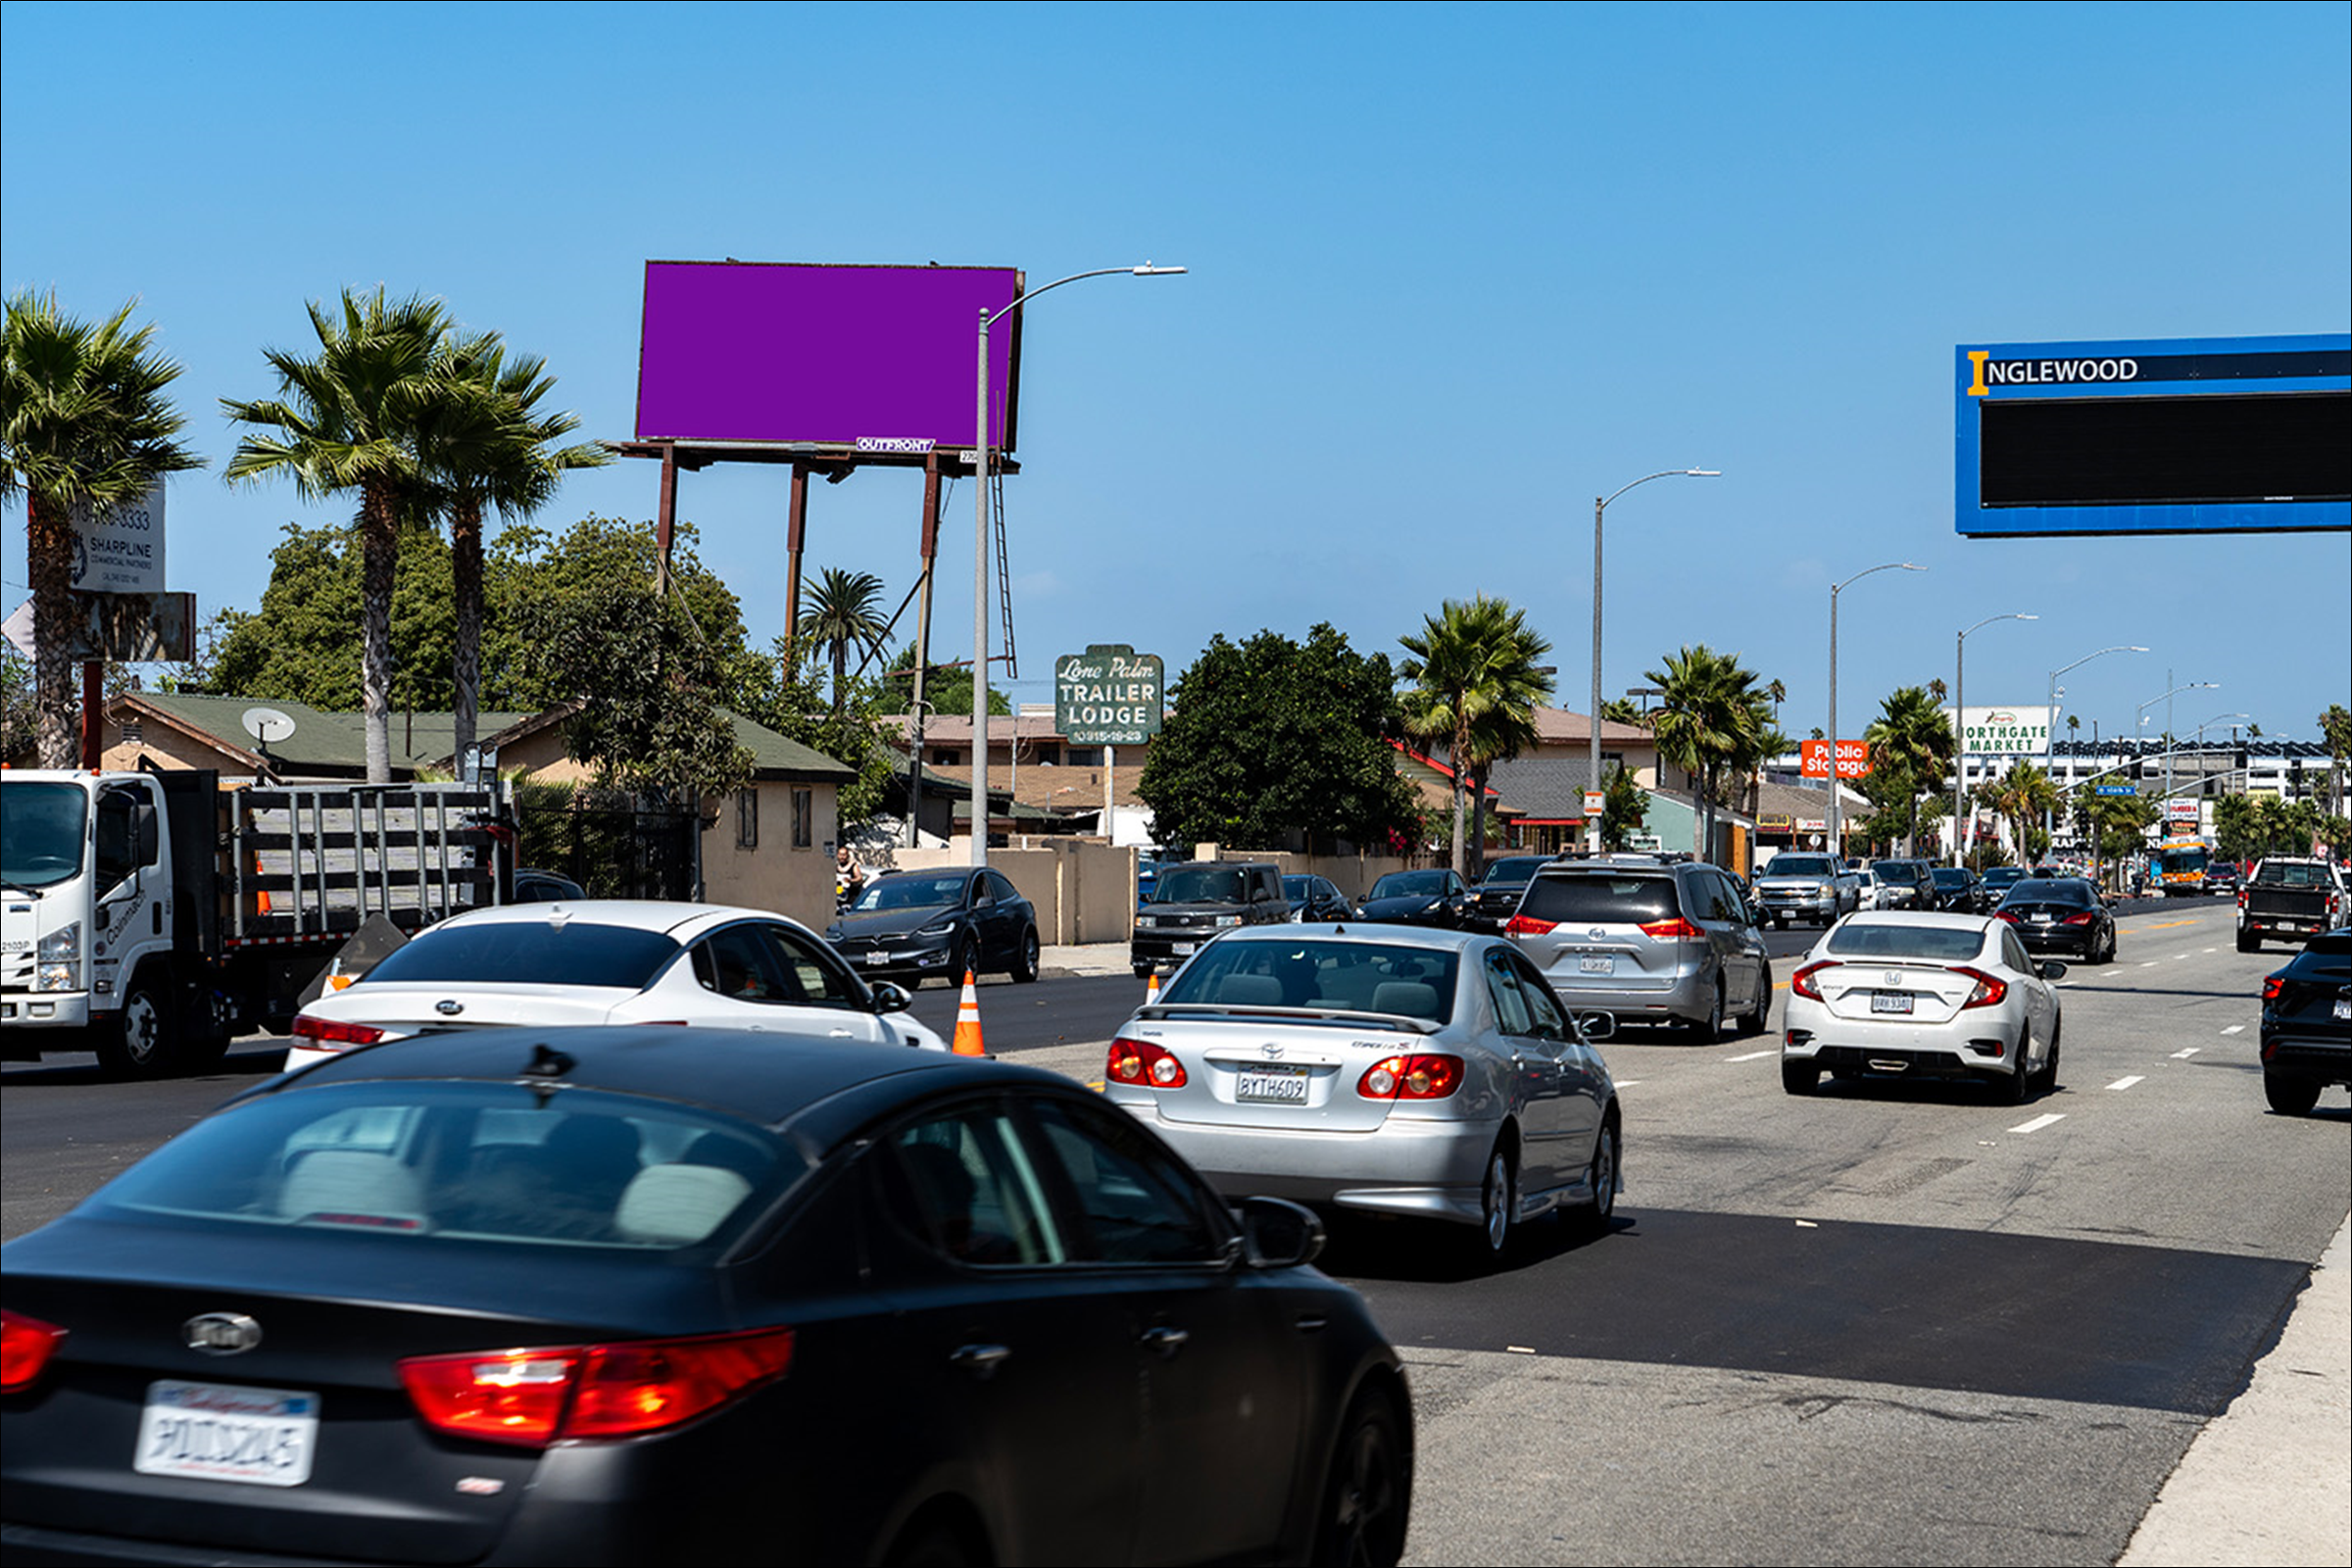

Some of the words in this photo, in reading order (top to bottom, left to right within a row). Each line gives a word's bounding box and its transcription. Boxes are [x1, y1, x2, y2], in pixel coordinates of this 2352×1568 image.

[1968, 351, 2138, 396] INGLEWOOD
[858, 438, 934, 451] OUTFRONT
[90, 536, 152, 558] SHARPLINE
[1058, 659, 1102, 682] Lone
[1108, 657, 1155, 678] Palm
[1059, 684, 1155, 702] TRAILER
[1068, 707, 1147, 724] LODGE
[1970, 740, 2033, 751] MARKET
[1806, 758, 1869, 775] Stoage
[1241, 1078, 1304, 1098] 8YTH609
